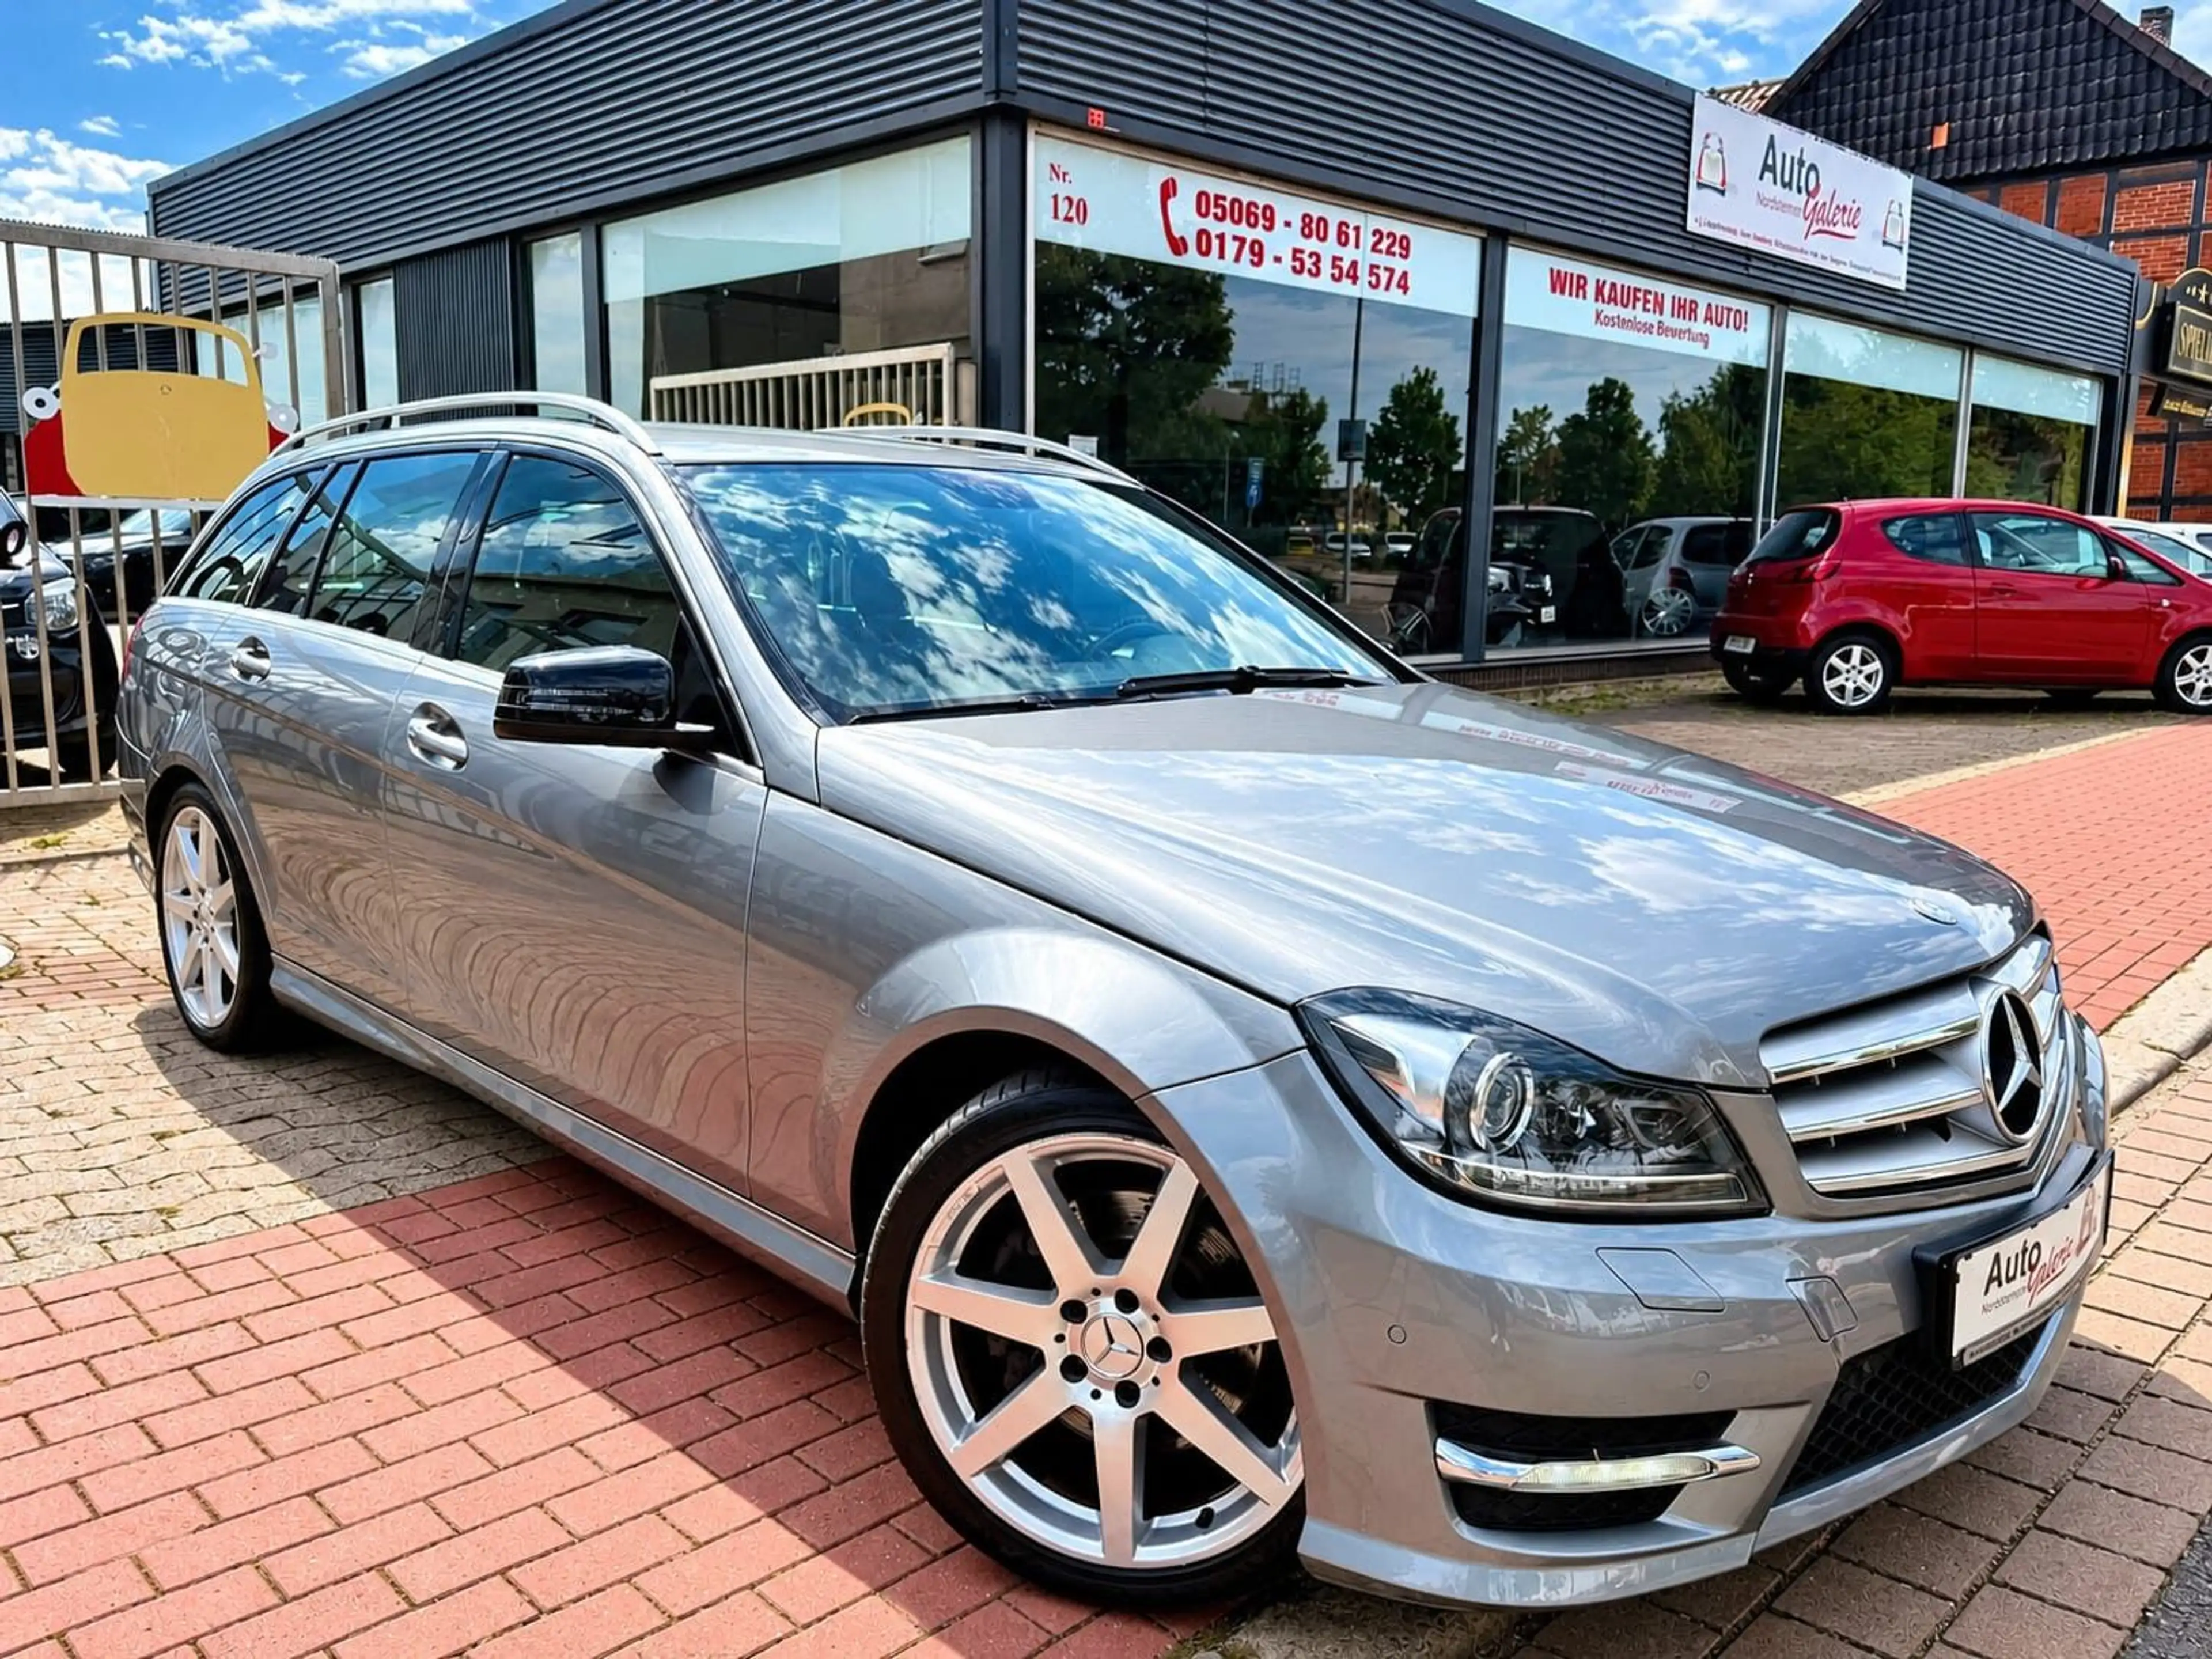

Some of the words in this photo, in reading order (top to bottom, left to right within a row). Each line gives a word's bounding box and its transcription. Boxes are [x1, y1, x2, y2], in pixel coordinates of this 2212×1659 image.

[1050, 163, 1072, 184] Nr.
[1758, 134, 1820, 198] Auto
[1051, 194, 1089, 225] 120
[1195, 190, 1277, 233] 05069
[1300, 213, 1330, 243] 80
[1335, 219, 1362, 249] 61
[1370, 228, 1412, 261] 229
[1802, 188, 1862, 240] Galerie
[1195, 228, 1266, 268] 0179
[1291, 247, 1322, 279] 53
[1330, 254, 1359, 286] 54
[1368, 263, 1411, 296] 574
[1548, 267, 1588, 300] WIR
[1593, 278, 1665, 316] KAUFEN
[1671, 294, 1699, 322] IHR
[1703, 303, 1749, 333] AUTO!
[1594, 309, 1655, 336] Kostenlose
[1656, 320, 1709, 349] Bewertung
[1984, 1239, 2042, 1296] Auto
